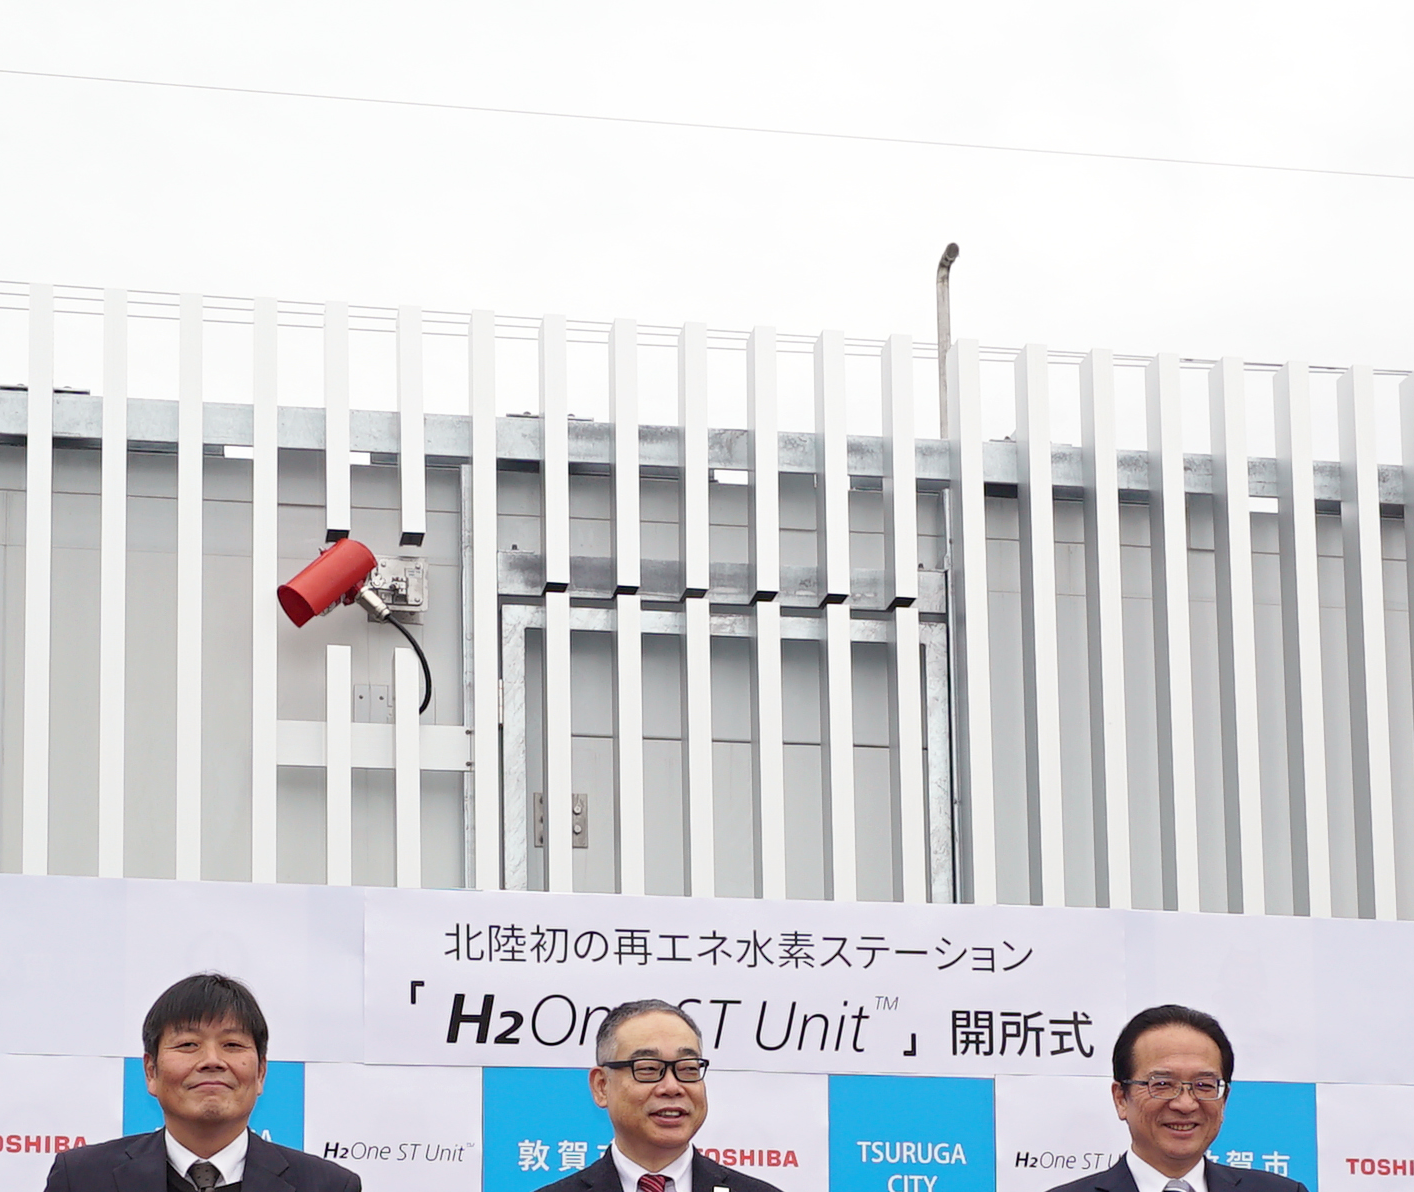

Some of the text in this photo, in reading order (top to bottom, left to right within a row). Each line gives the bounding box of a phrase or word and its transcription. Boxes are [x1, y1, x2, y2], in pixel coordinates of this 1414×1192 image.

[444, 922, 1033, 973] 北陸初の再エネ水素ステーション
[446, 993, 612, 1046] H2On
[323, 1141, 391, 1161] H2One
[396, 1143, 420, 1161] ST
[856, 1140, 967, 1165] TSURUGA
[1014, 1151, 1077, 1169] H2One
[1081, 1152, 1104, 1170] ST
